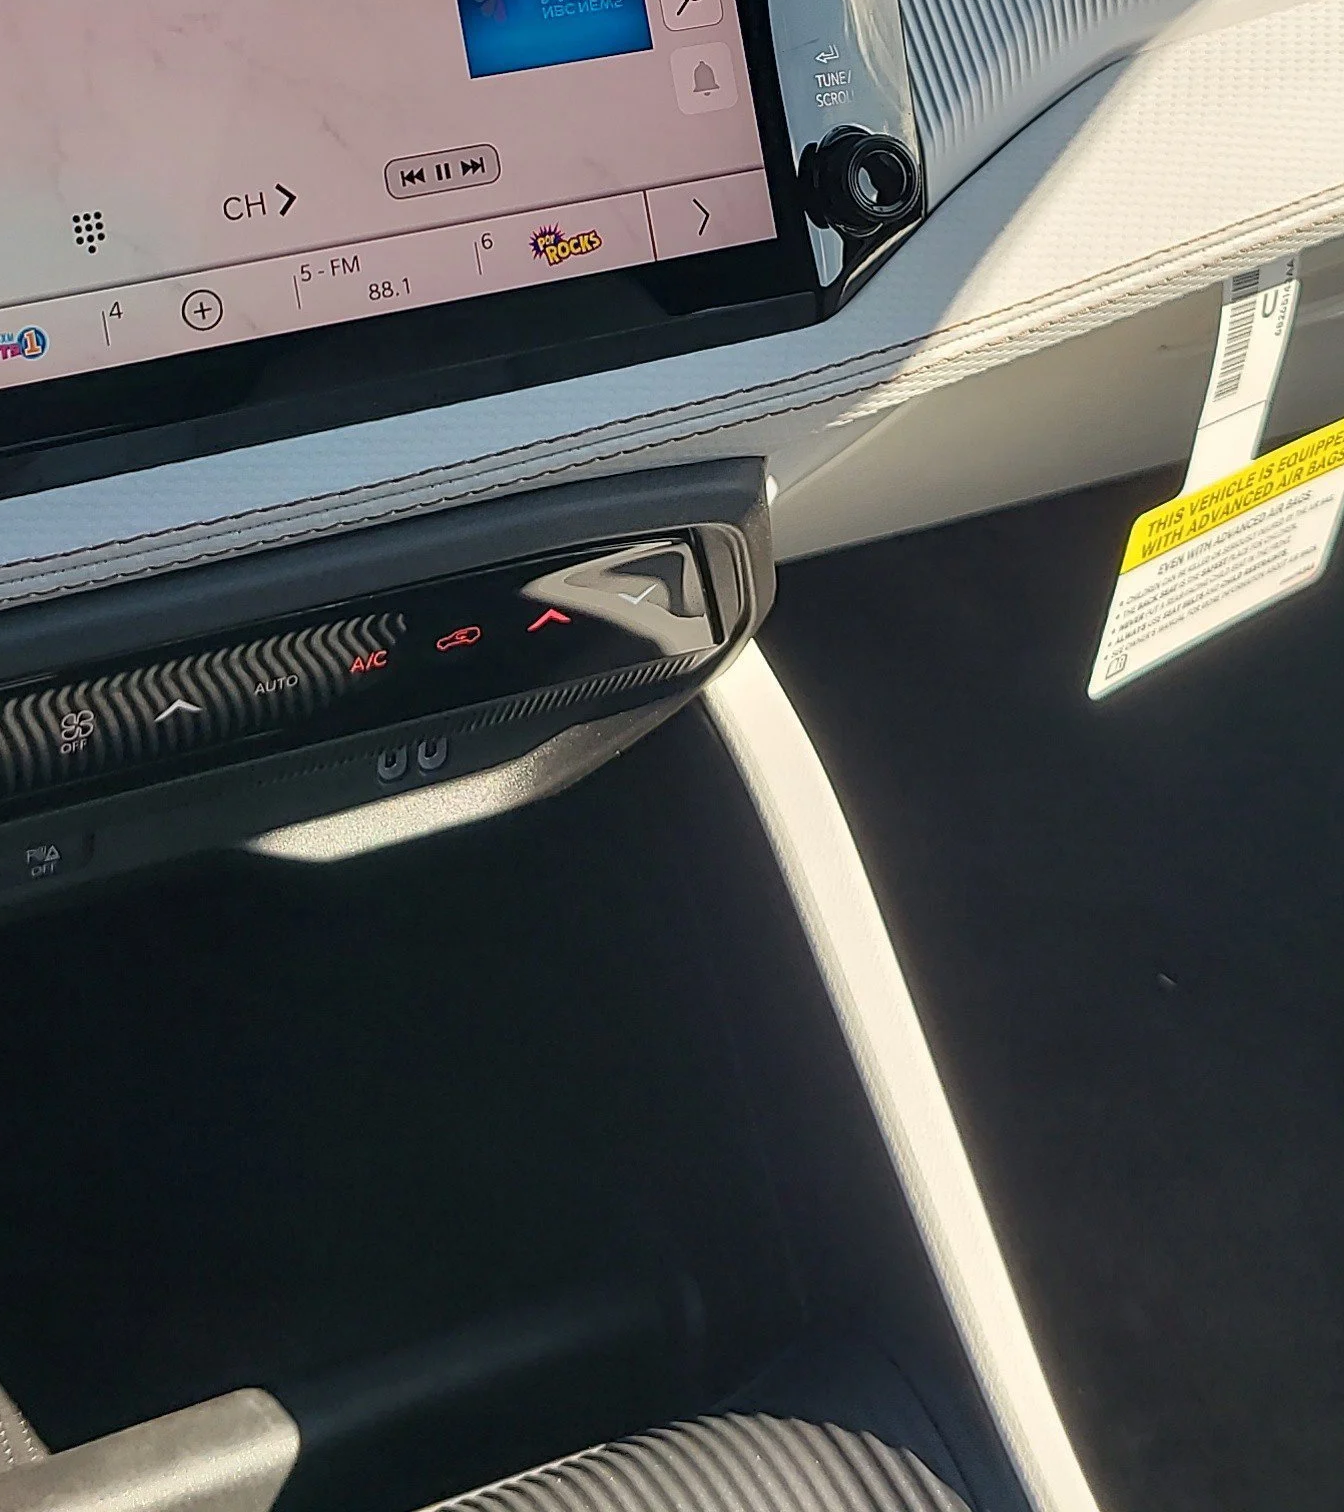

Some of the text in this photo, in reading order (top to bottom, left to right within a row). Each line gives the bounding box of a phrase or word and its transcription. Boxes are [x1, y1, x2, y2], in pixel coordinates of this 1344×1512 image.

[223, 191, 267, 222] CH
[481, 233, 494, 251] 6
[545, 230, 601, 264] ROCKS
[300, 264, 311, 283] 5
[330, 254, 361, 277] FM
[368, 277, 412, 301] 88.1
[109, 301, 124, 321] 4
[1139, 523, 1184, 560] WITH
[1185, 478, 1275, 537] ADVANCED
[1275, 464, 1305, 491] AIR
[1144, 505, 1185, 539] THIS
[1185, 470, 1256, 518] VEHICLE
[1257, 461, 1275, 483] IS
[1157, 552, 1185, 575] EVEN
[1185, 538, 1212, 561] WITH
[1213, 510, 1267, 546] ADVANCED
[1267, 501, 1285, 518] AIR
[350, 650, 388, 673] A/C
[254, 675, 298, 694] AUTO
[60, 741, 88, 754] OFF
